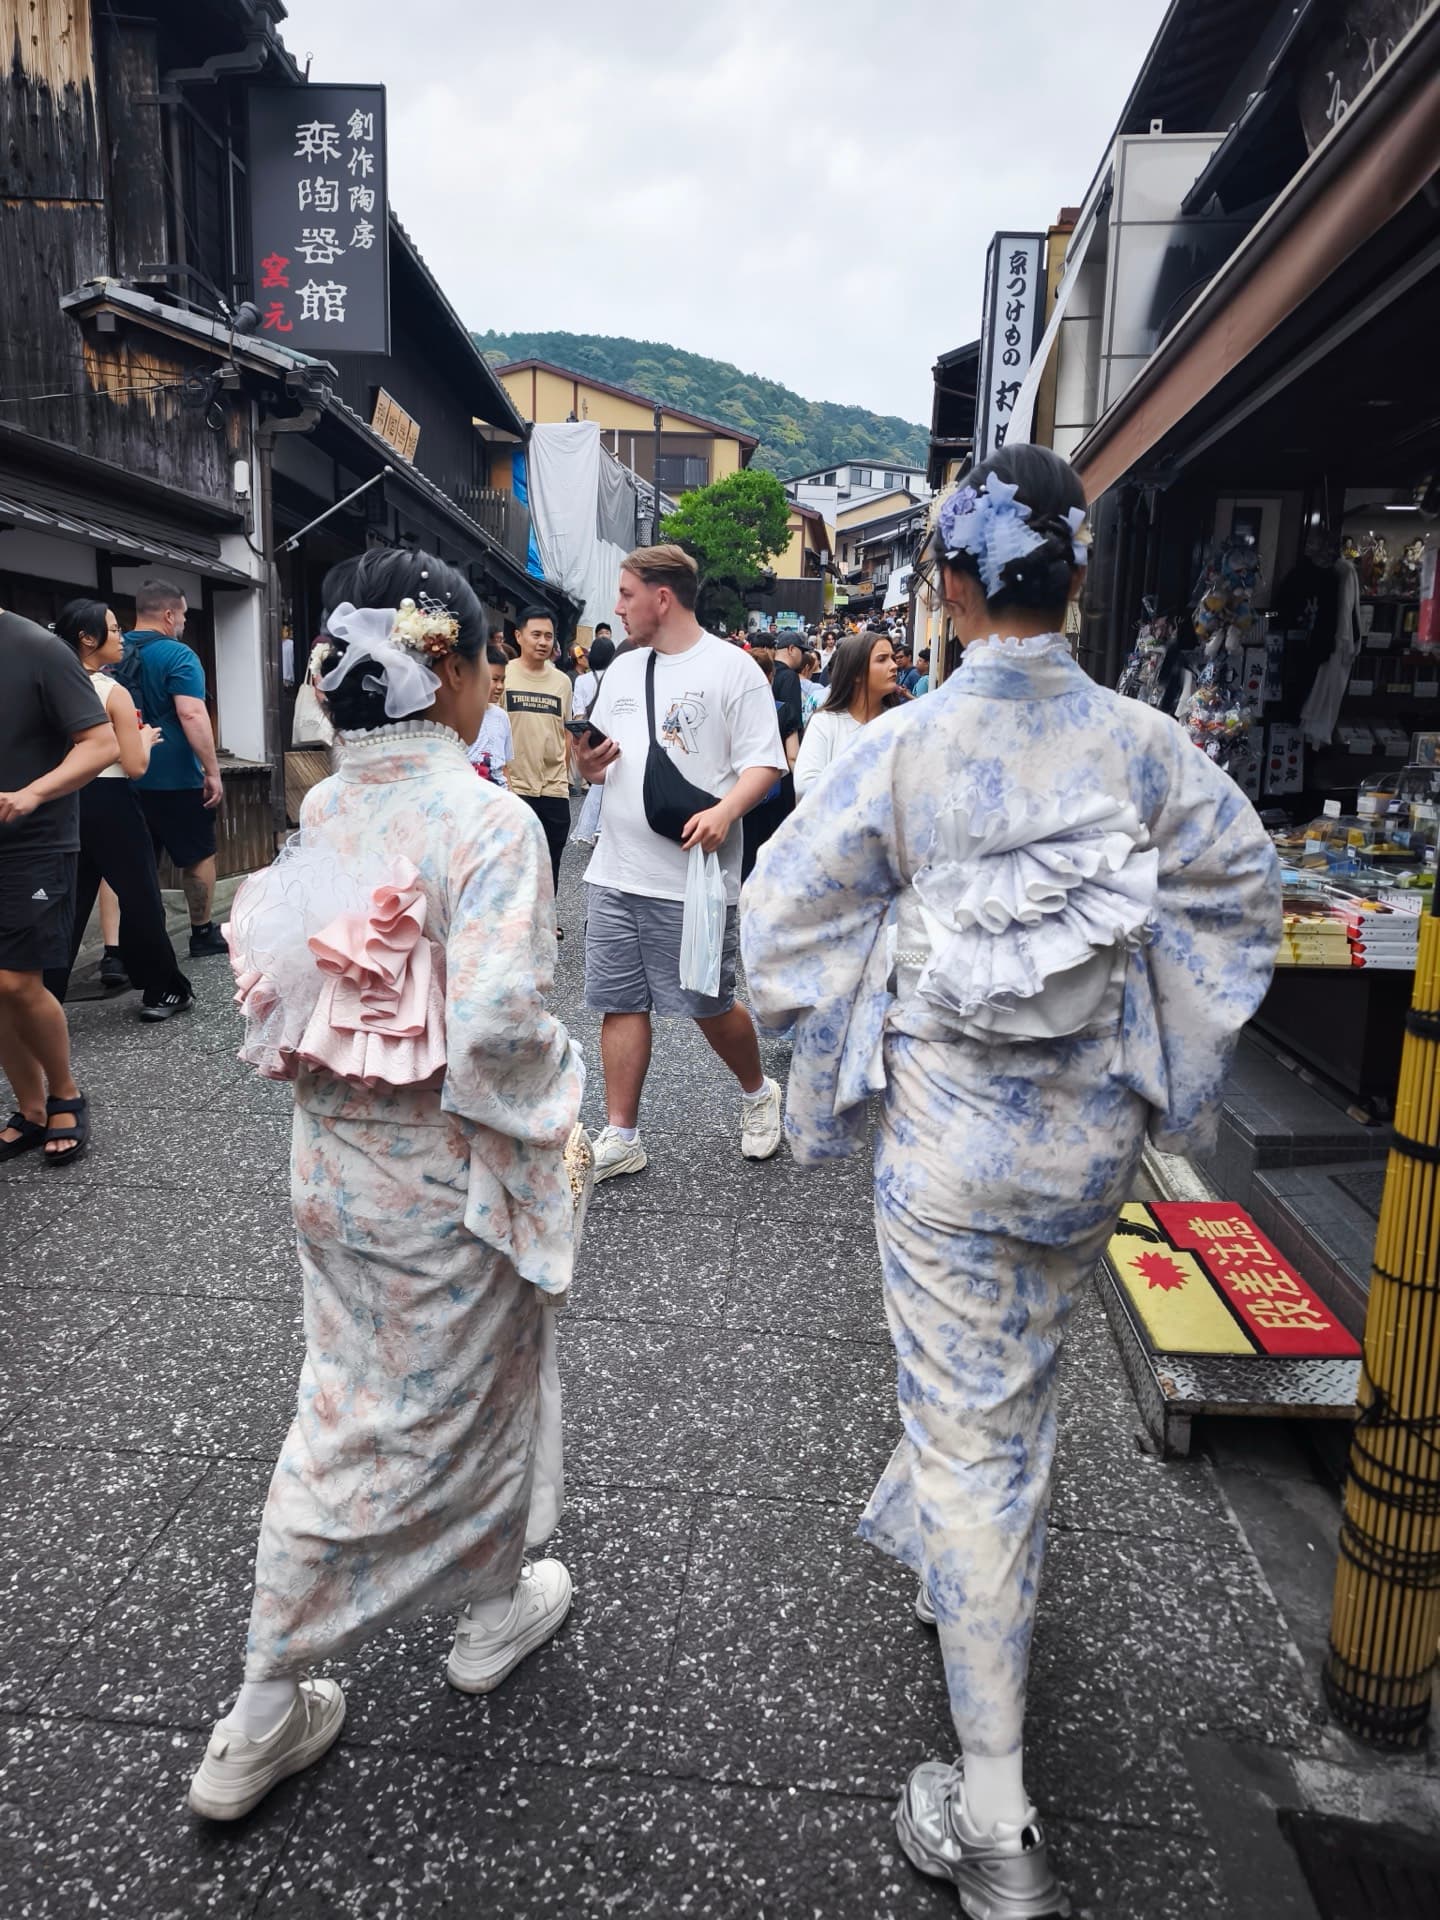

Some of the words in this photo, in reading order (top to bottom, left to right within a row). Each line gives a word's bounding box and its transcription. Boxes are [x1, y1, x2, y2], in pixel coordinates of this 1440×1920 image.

[294, 120, 347, 323] 森陶器館
[347, 109, 376, 249] 創作陶房
[1003, 250, 1028, 366] 京つけもの
[1188, 1217, 1331, 1331] 段差注意
